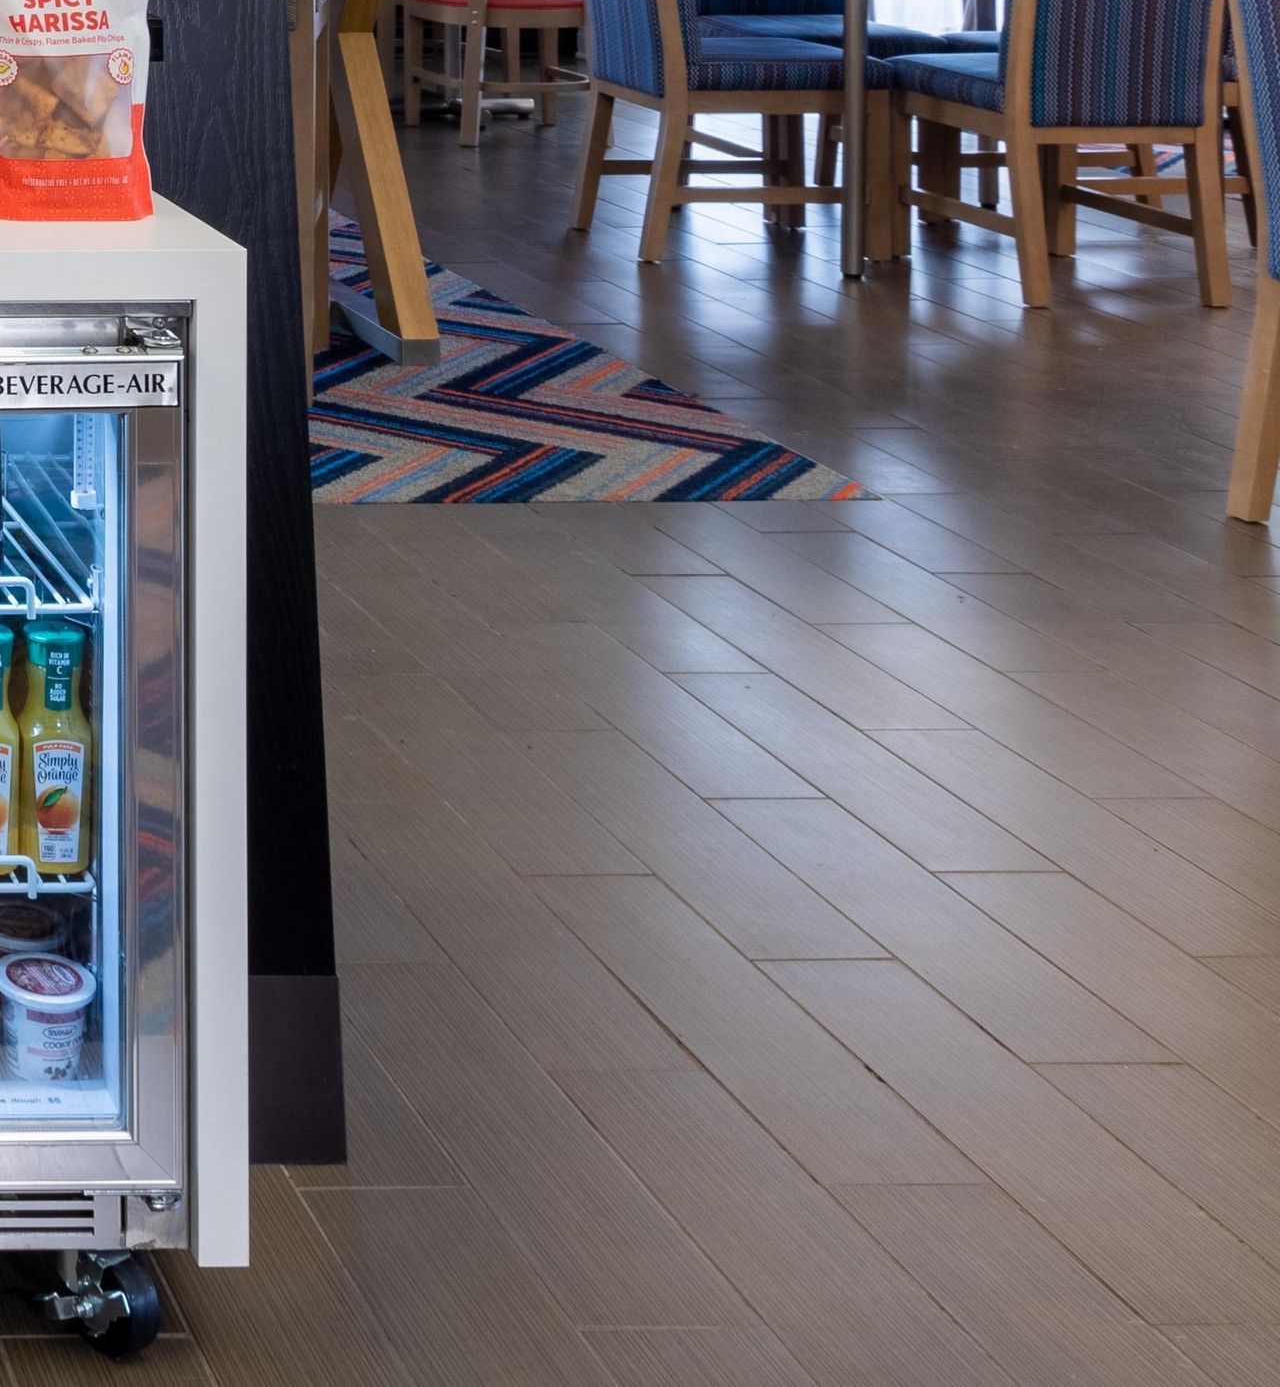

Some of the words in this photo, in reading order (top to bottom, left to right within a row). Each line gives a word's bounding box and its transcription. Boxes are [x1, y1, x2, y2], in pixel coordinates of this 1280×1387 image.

[8, 9, 110, 34] HARISSA
[45, 36, 70, 45] Flame
[71, 35, 96, 44] Baked
